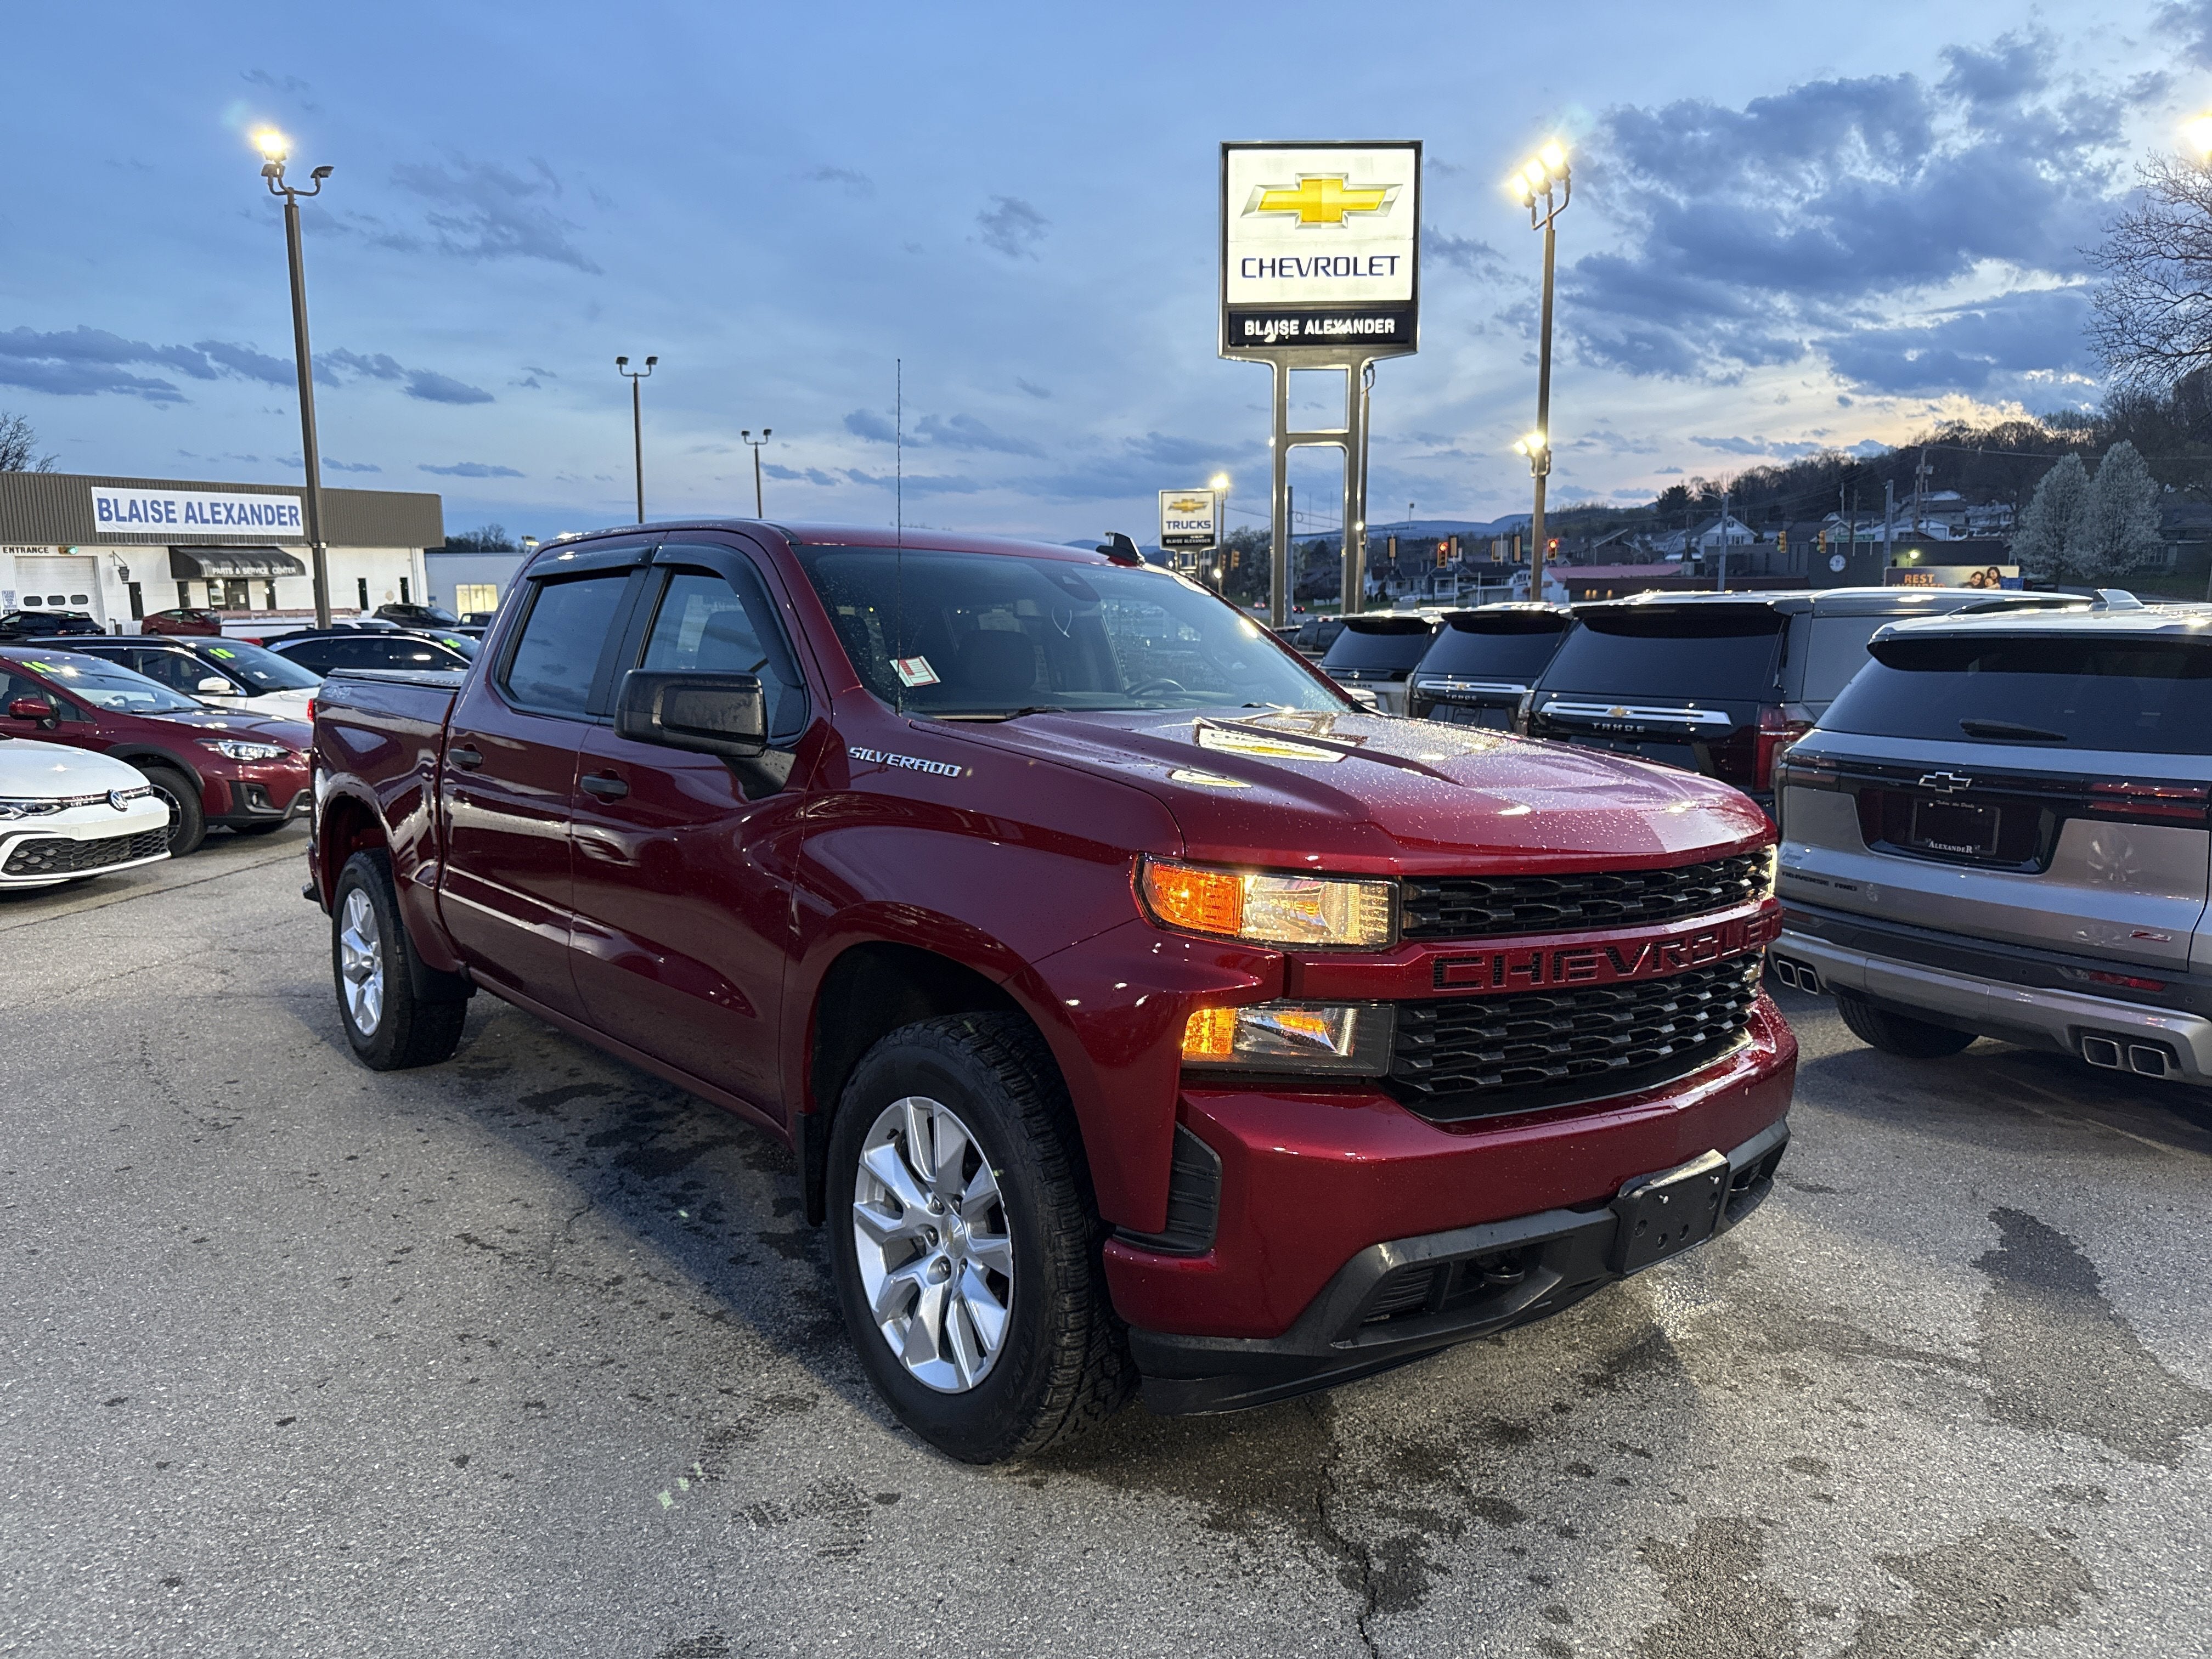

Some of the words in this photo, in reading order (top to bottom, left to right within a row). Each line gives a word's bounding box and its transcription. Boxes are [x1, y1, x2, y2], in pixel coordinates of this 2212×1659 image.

[1241, 255, 1401, 278] CHEVROLET
[1244, 320, 1300, 336] BLAISE
[1304, 318, 1395, 336] ALEXANDER
[97, 498, 177, 523] BLAISE
[184, 501, 301, 527] ALEXANDER
[1166, 520, 1211, 529] TRUCKS
[1592, 722, 1645, 732] TAHOE
[848, 746, 962, 777] SILVERADO
[1928, 840, 1973, 854] ALEXANDER
[1432, 906, 1781, 991] CHEVROLET
